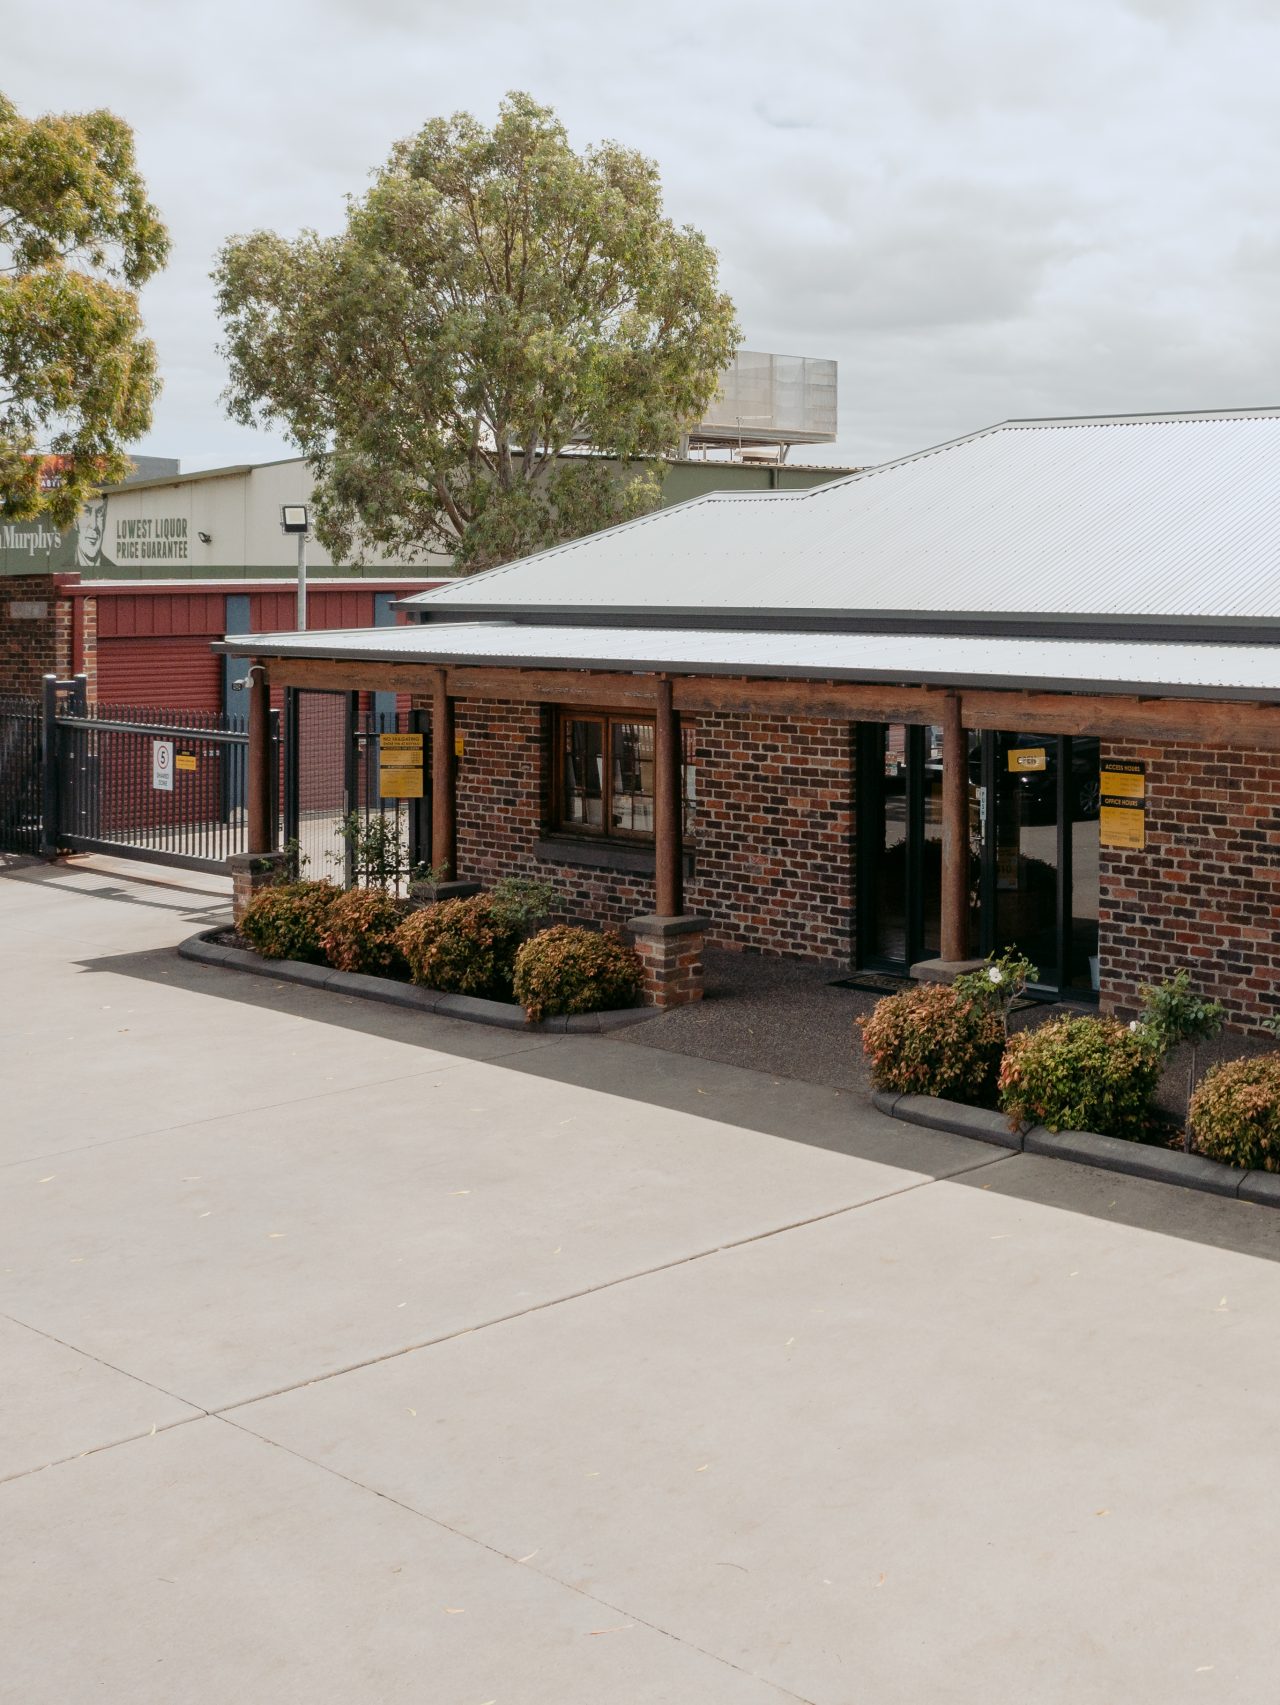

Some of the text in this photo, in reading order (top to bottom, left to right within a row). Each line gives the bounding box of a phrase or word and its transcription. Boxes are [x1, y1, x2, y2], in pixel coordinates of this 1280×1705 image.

[116, 518, 188, 540] LOWEST LIQUOR
[2, 524, 62, 556] Murphy's
[116, 541, 188, 559] PRICE GUARANTEE
[160, 751, 166, 764] 5
[1017, 755, 1037, 765] OPEN
